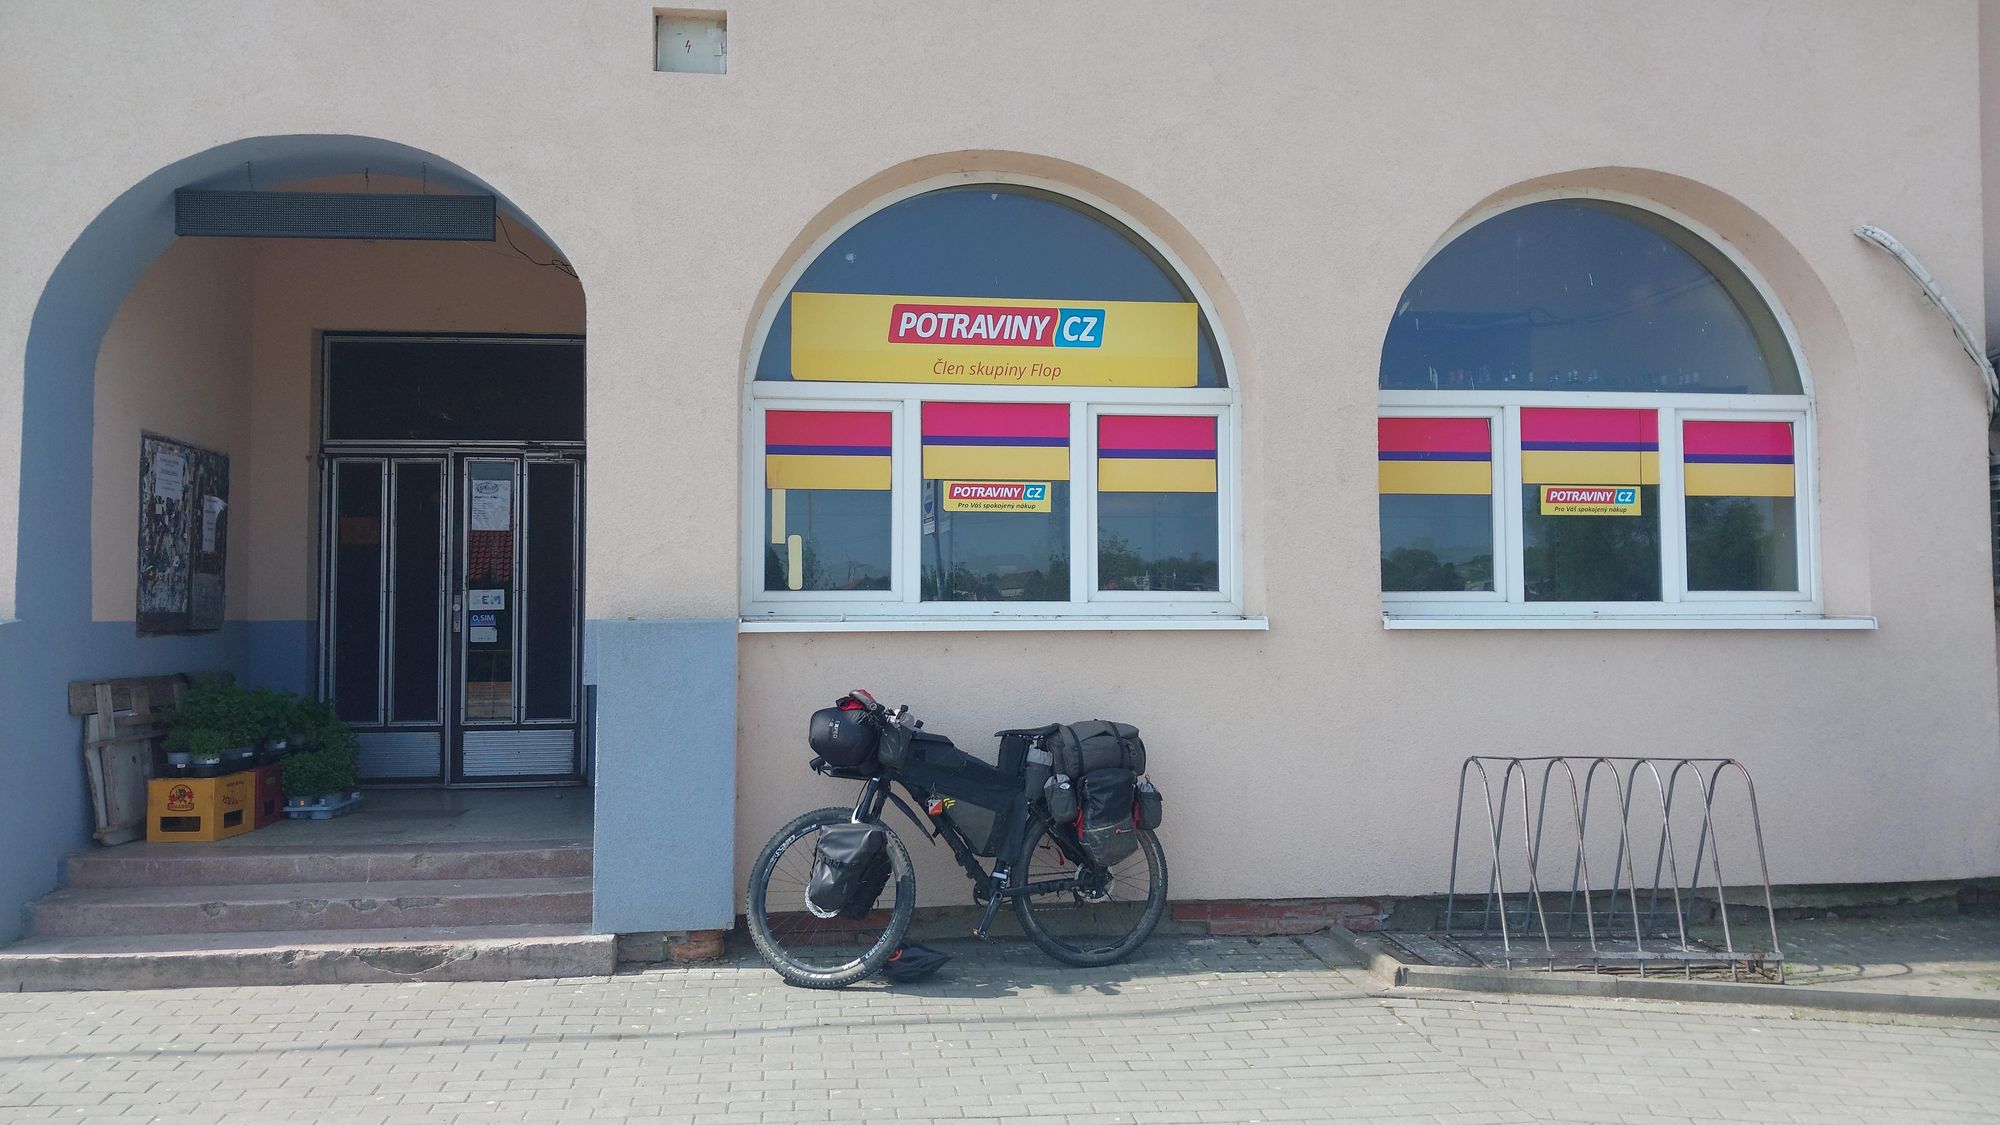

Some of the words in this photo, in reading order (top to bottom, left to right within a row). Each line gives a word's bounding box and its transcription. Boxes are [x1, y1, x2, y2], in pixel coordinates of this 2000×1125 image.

[899, 312, 1050, 341] POTRAVINY
[1063, 316, 1098, 342] CZ
[933, 358, 965, 375] Člen
[969, 362, 1027, 380] skupiny
[1030, 363, 1062, 380] Flop
[953, 487, 1021, 498] POTRAVINY
[1026, 488, 1043, 498] CZ
[1550, 491, 1613, 502] POTRAVINY
[1617, 492, 1632, 502] CZ
